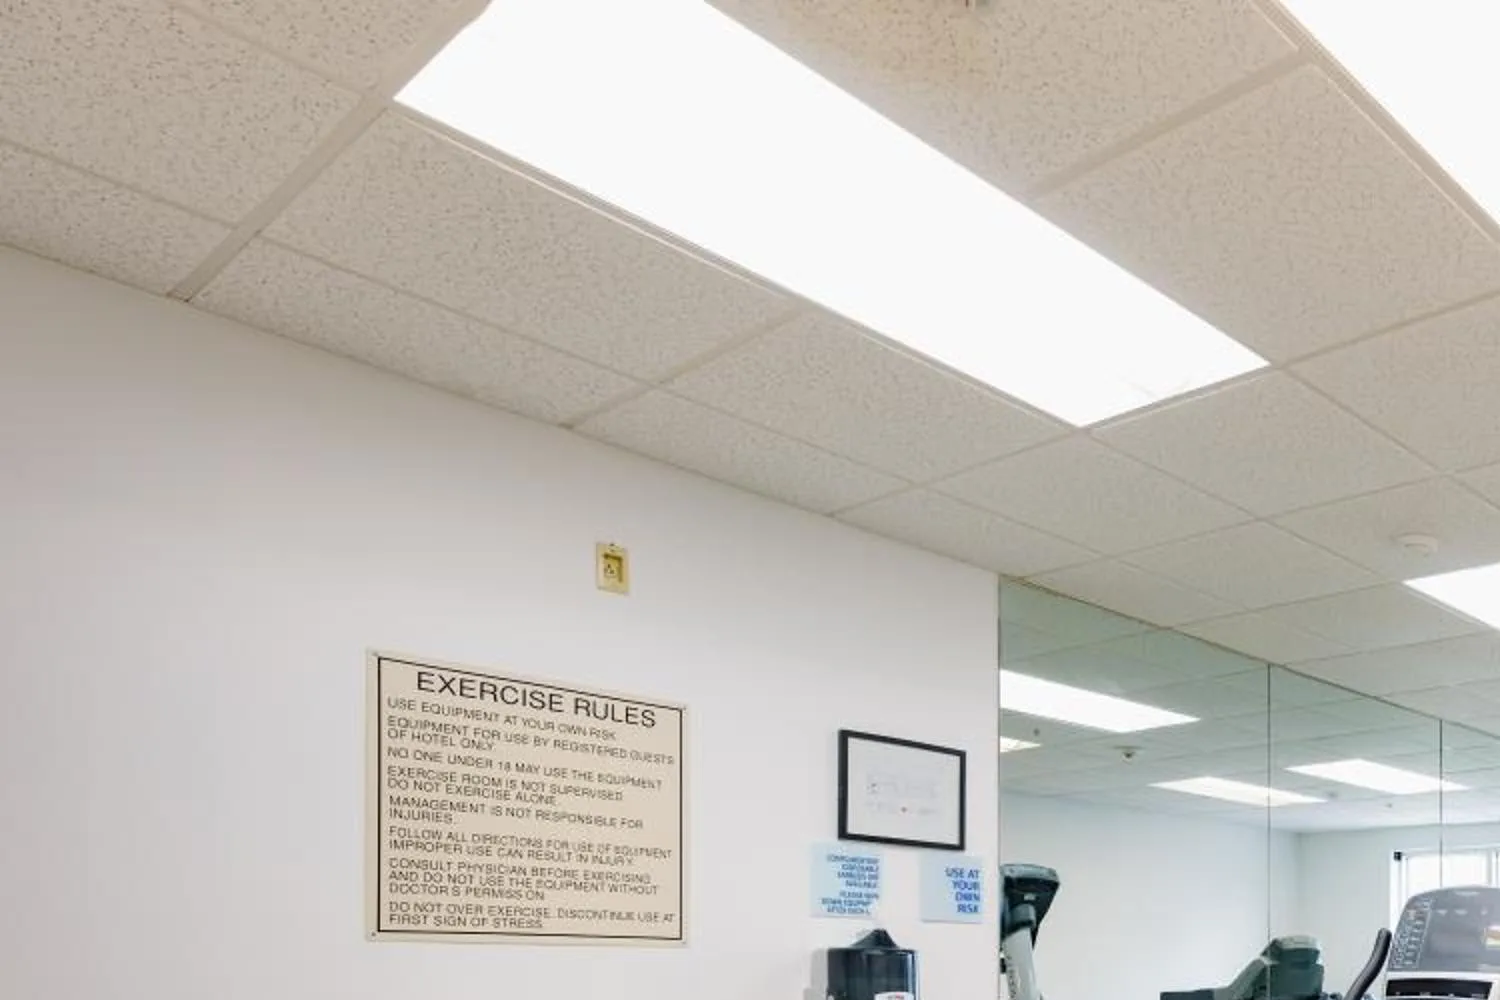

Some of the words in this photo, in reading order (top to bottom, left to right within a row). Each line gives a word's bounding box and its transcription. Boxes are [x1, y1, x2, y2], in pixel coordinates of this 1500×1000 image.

[417, 671, 564, 713] EXERCISE
[574, 698, 656, 728] RULES
[387, 696, 416, 711] USE
[421, 702, 499, 722] EQUIPMENT
[503, 715, 519, 726] AT
[521, 717, 554, 732] YOUR
[557, 724, 587, 737] OWN
[387, 727, 407, 740] OF
[411, 731, 456, 747] HOTEL
[387, 716, 469, 736] EQUIPMENT
[473, 727, 500, 741] FOR
[505, 731, 529, 745] USE
[533, 735, 549, 747] BY
[553, 739, 627, 759] REGISTERED
[629, 750, 675, 765] GUESTS
[387, 746, 409, 759] NO
[413, 749, 443, 763] ONE
[447, 754, 493, 769] UNDER
[498, 761, 511, 772] 18
[515, 762, 540, 775] MAY
[543, 766, 568, 779] USE
[571, 769, 594, 783] THE
[597, 773, 662, 790] EQUIPMENT
[387, 765, 457, 783] EXERCISE
[461, 773, 502, 788] ROOM
[505, 779, 517, 790] IS
[521, 780, 545, 792] NOT
[550, 783, 623, 801] SUPERVISED
[387, 778, 409, 790] DO
[413, 780, 441, 793] NOT
[445, 783, 511, 801] EXERCISE
[389, 795, 486, 813] MANAGEMENT
[490, 805, 503, 817] IS
[506, 807, 531, 818] NOT
[535, 809, 617, 825] RESPONSIBLE
[620, 817, 643, 829] FOR
[389, 826, 442, 841] FOLLOW
[447, 831, 467, 843] ALL
[471, 833, 542, 848] DIRECTIONS
[546, 839, 568, 850] FOR
[572, 841, 593, 853] USE
[597, 843, 612, 854] OF
[614, 845, 672, 859] EQUIPMENT
[389, 840, 463, 855] IMPROPER
[467, 845, 492, 857] USE
[497, 847, 523, 859] CAN
[527, 849, 572, 863] RESULT
[576, 853, 589, 864] IN
[388, 870, 419, 881] AND
[423, 871, 443, 883] DO
[447, 873, 473, 885] NOT
[480, 875, 504, 887] USE
[509, 877, 532, 888] THE
[535, 878, 605, 893] EQUIPMENT
[608, 883, 657, 895] WITHOUT
[389, 858, 452, 871] CONSULT
[457, 861, 527, 876] PHYSICIAN
[531, 867, 579, 880] BEFORE
[583, 870, 651, 885] EXERCISING
[945, 867, 964, 878] USE
[967, 868, 979, 879] AT
[389, 882, 461, 896] DOCTORS
[952, 880, 980, 891] YOUR
[955, 891, 980, 902] OWN
[389, 901, 410, 912] DO
[414, 902, 443, 913] NOT
[446, 903, 483, 915] OVER
[557, 907, 636, 921] DISCONTINUE
[638, 911, 660, 922] USE
[663, 912, 675, 922] AT
[389, 913, 428, 925] FIRST
[433, 915, 467, 926] SIGN
[470, 917, 487, 927] OF
[957, 903, 979, 913] RISK
